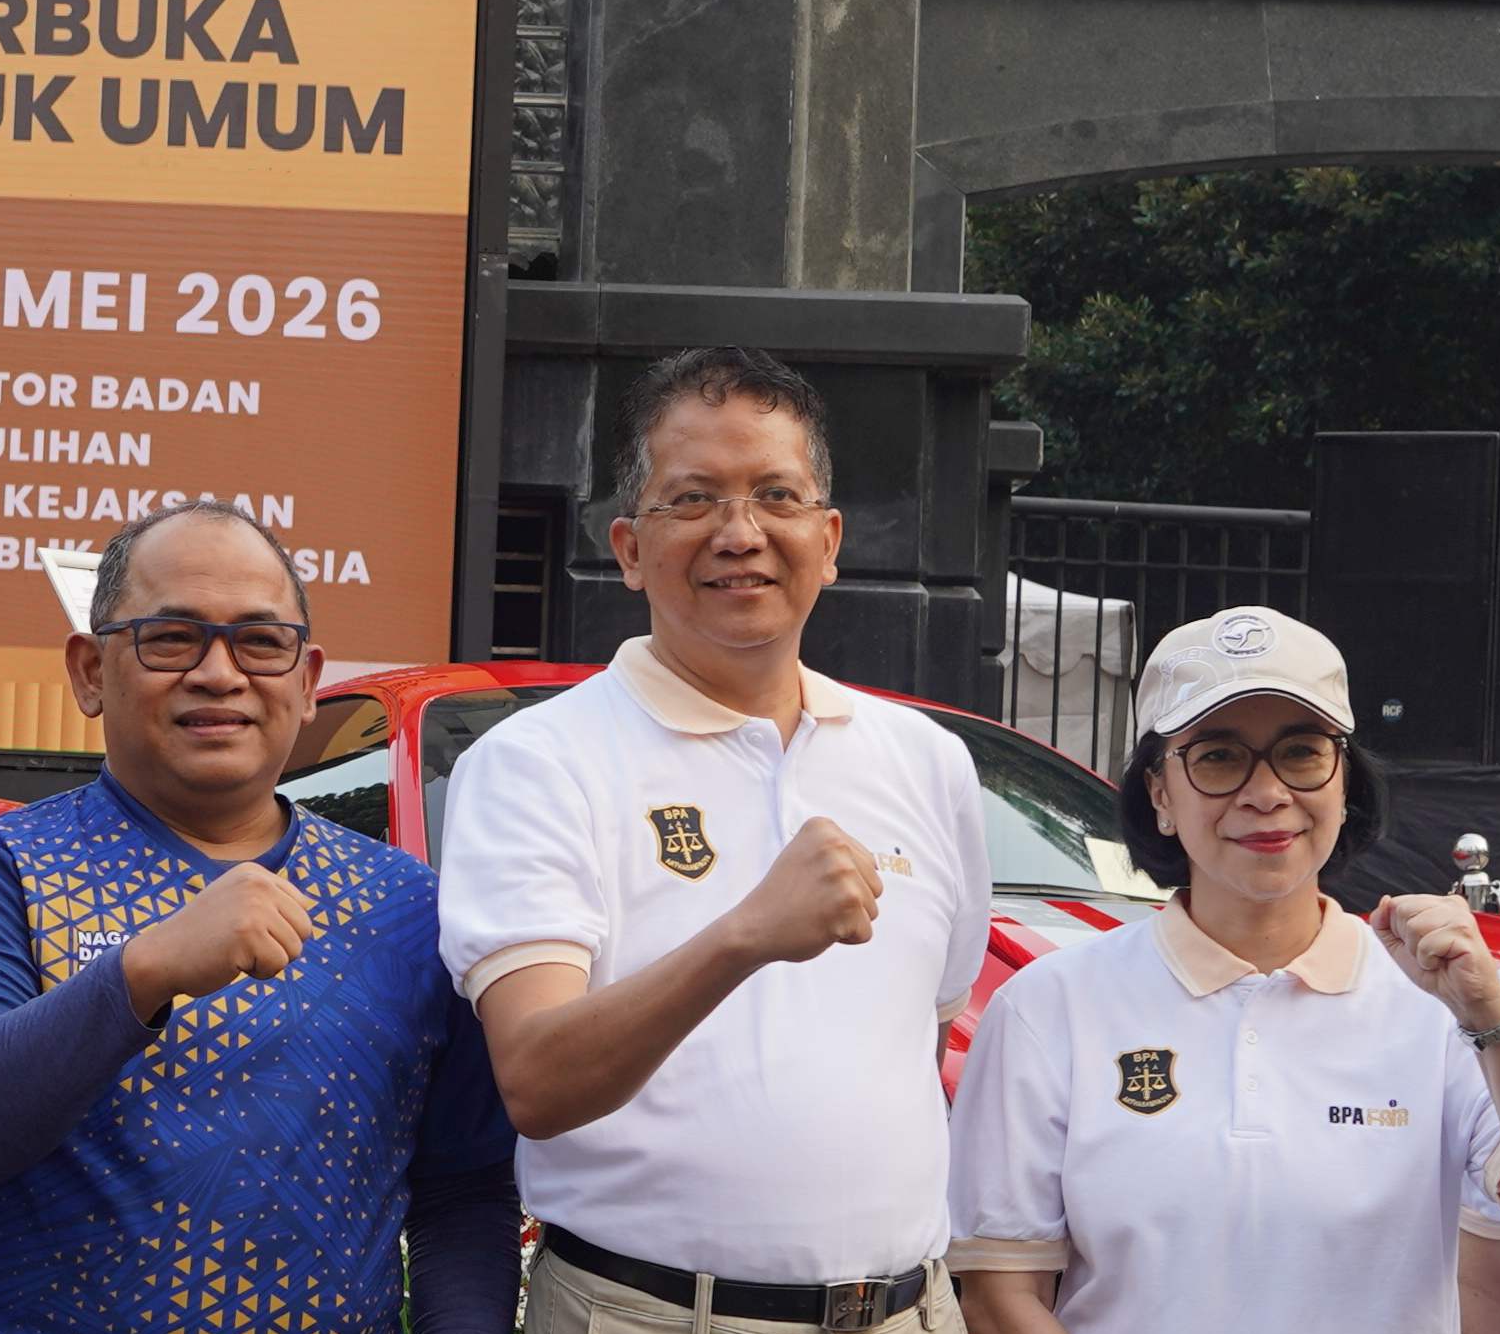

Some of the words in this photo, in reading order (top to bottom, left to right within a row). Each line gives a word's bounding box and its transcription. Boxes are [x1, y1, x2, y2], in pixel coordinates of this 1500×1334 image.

[100, 76, 405, 156] UMUM
[3, 268, 147, 332] MEI
[175, 272, 382, 340] 2026
[91, 375, 261, 416] BADAN
[663, 808, 689, 820] BPA
[1132, 1052, 1160, 1063] BPA
[1328, 1106, 1364, 1125] BPA
